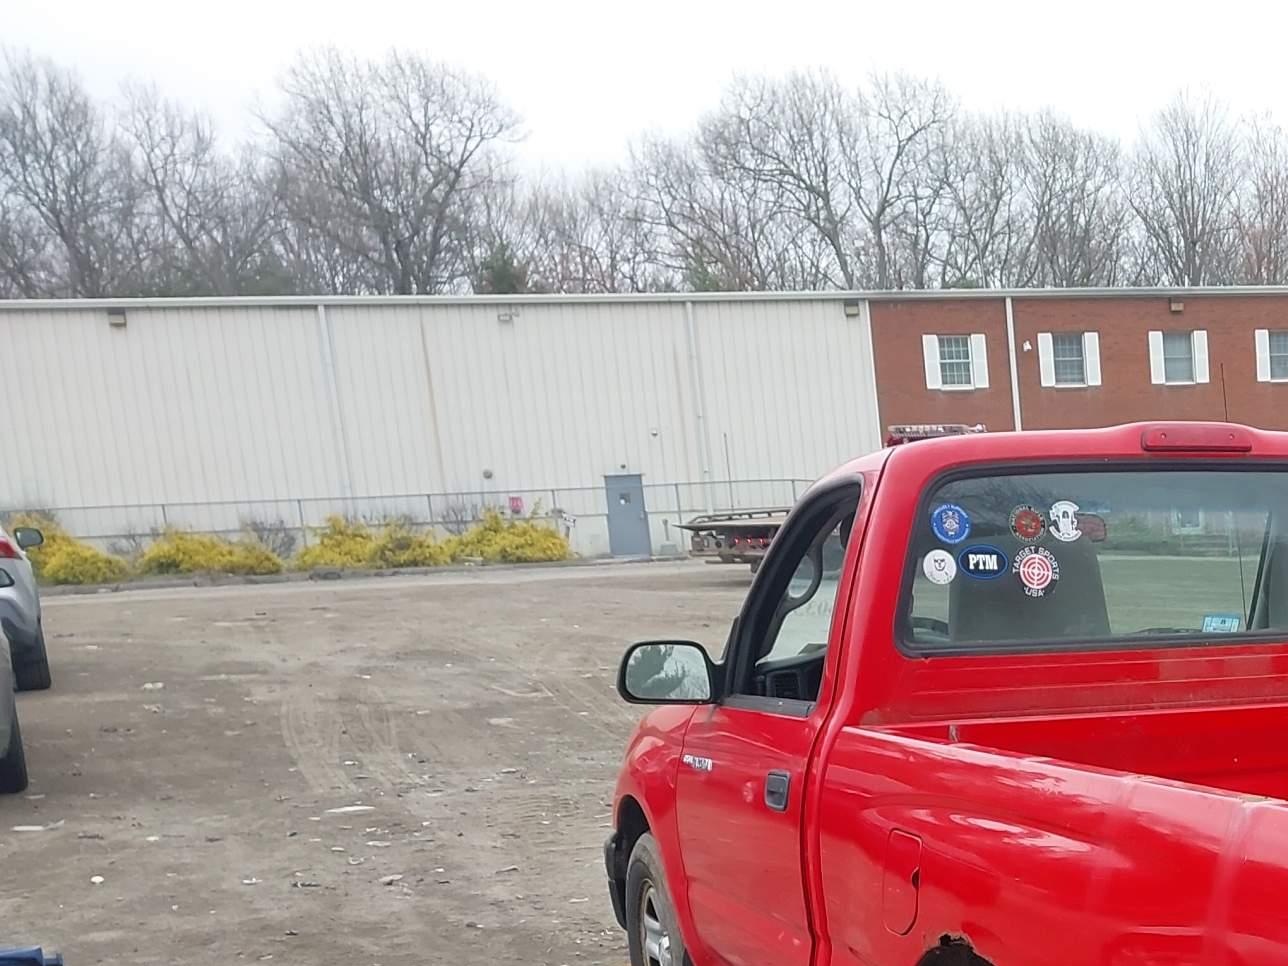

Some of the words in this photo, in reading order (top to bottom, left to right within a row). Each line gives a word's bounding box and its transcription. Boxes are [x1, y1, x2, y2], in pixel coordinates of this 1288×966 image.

[968, 554, 998, 571] PTM
[1012, 546, 1036, 574] TARGET
[1037, 546, 1060, 580] SPORTS
